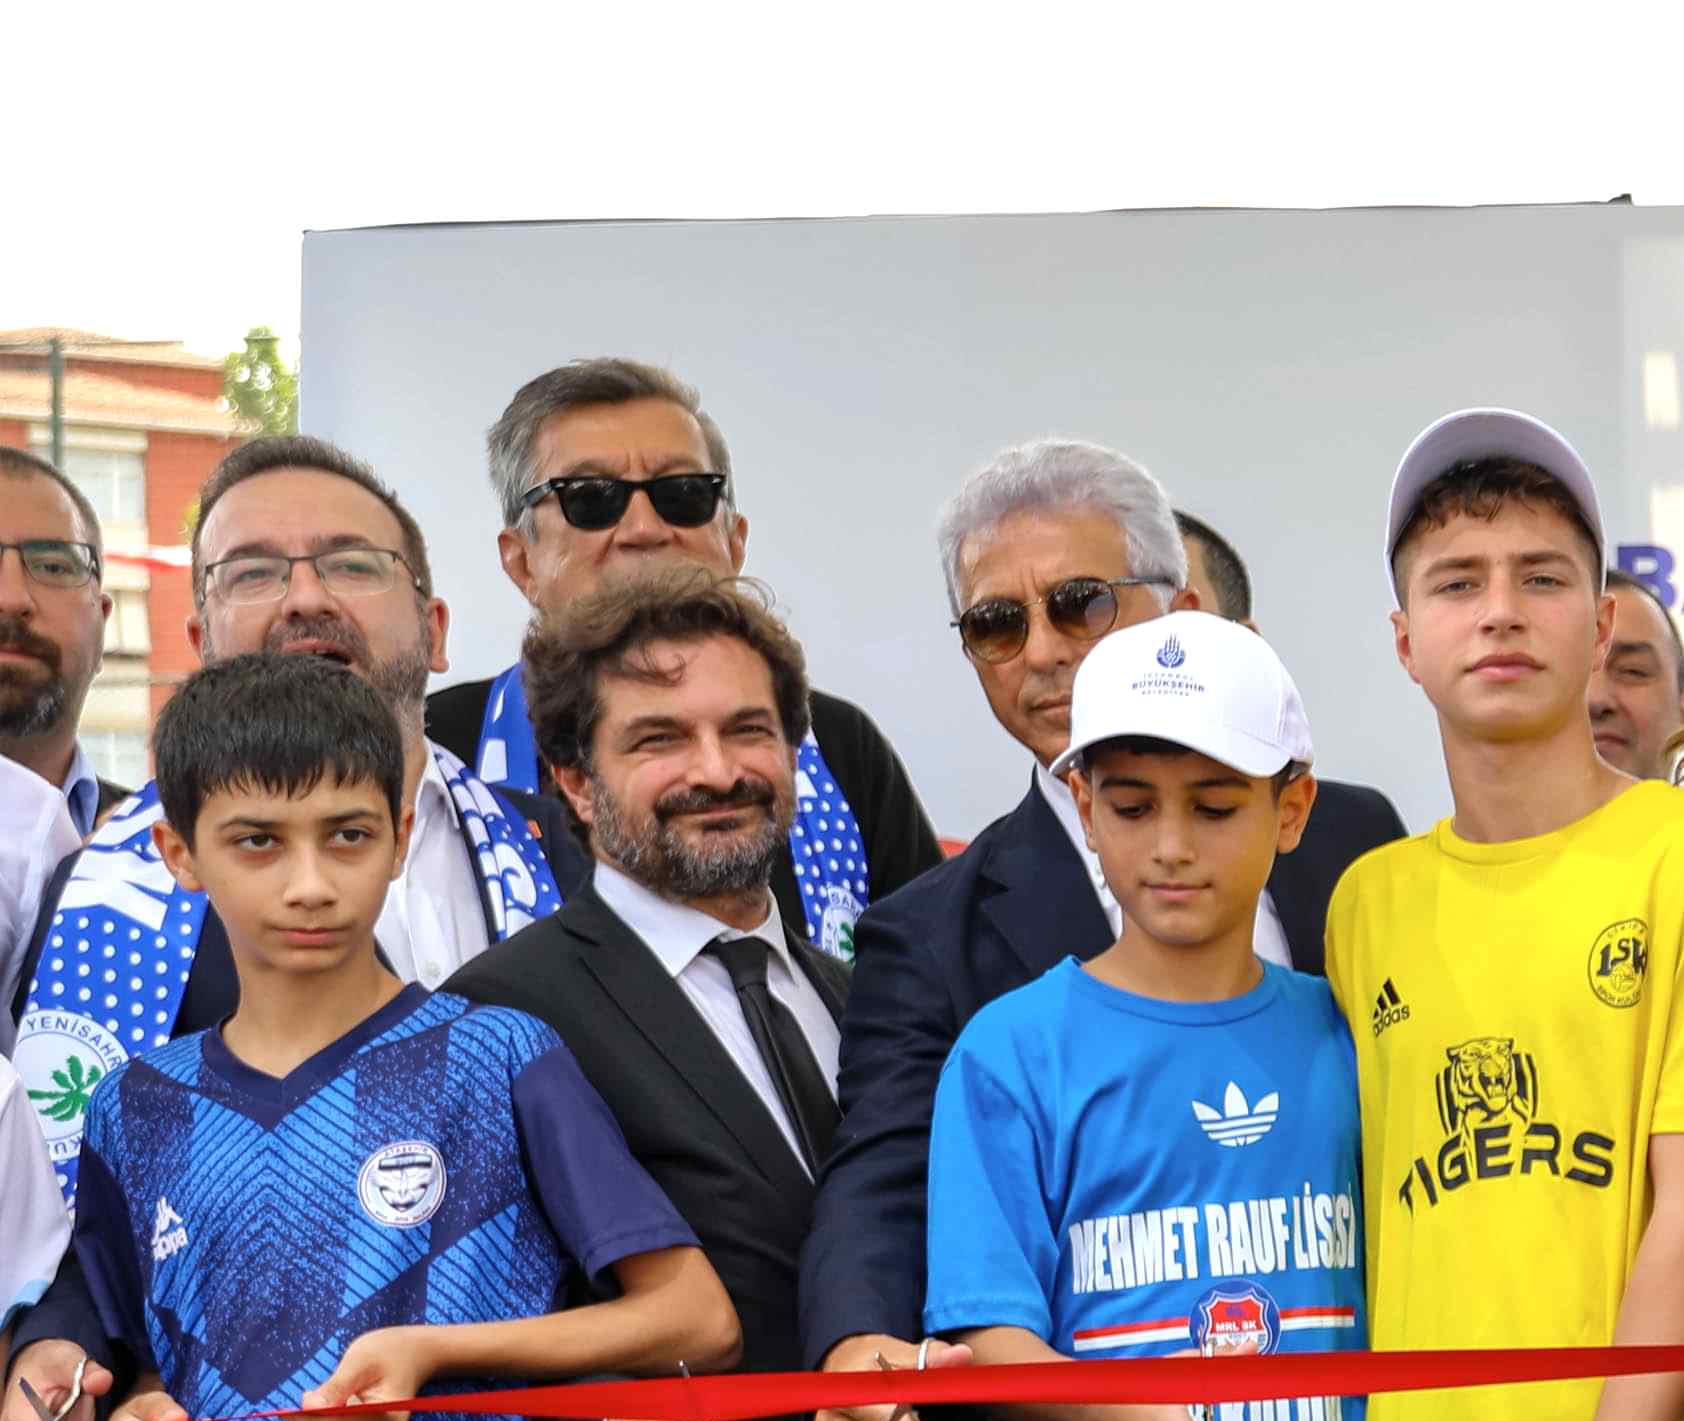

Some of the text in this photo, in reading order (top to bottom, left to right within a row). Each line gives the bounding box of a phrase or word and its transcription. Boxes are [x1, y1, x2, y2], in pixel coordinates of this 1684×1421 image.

[26, 1016, 122, 1069] YENİSAHR
[1399, 1123, 1616, 1217] TIGERS
[1069, 1207, 1199, 1294] MEHMET
[1205, 1197, 1289, 1277] RAUF
